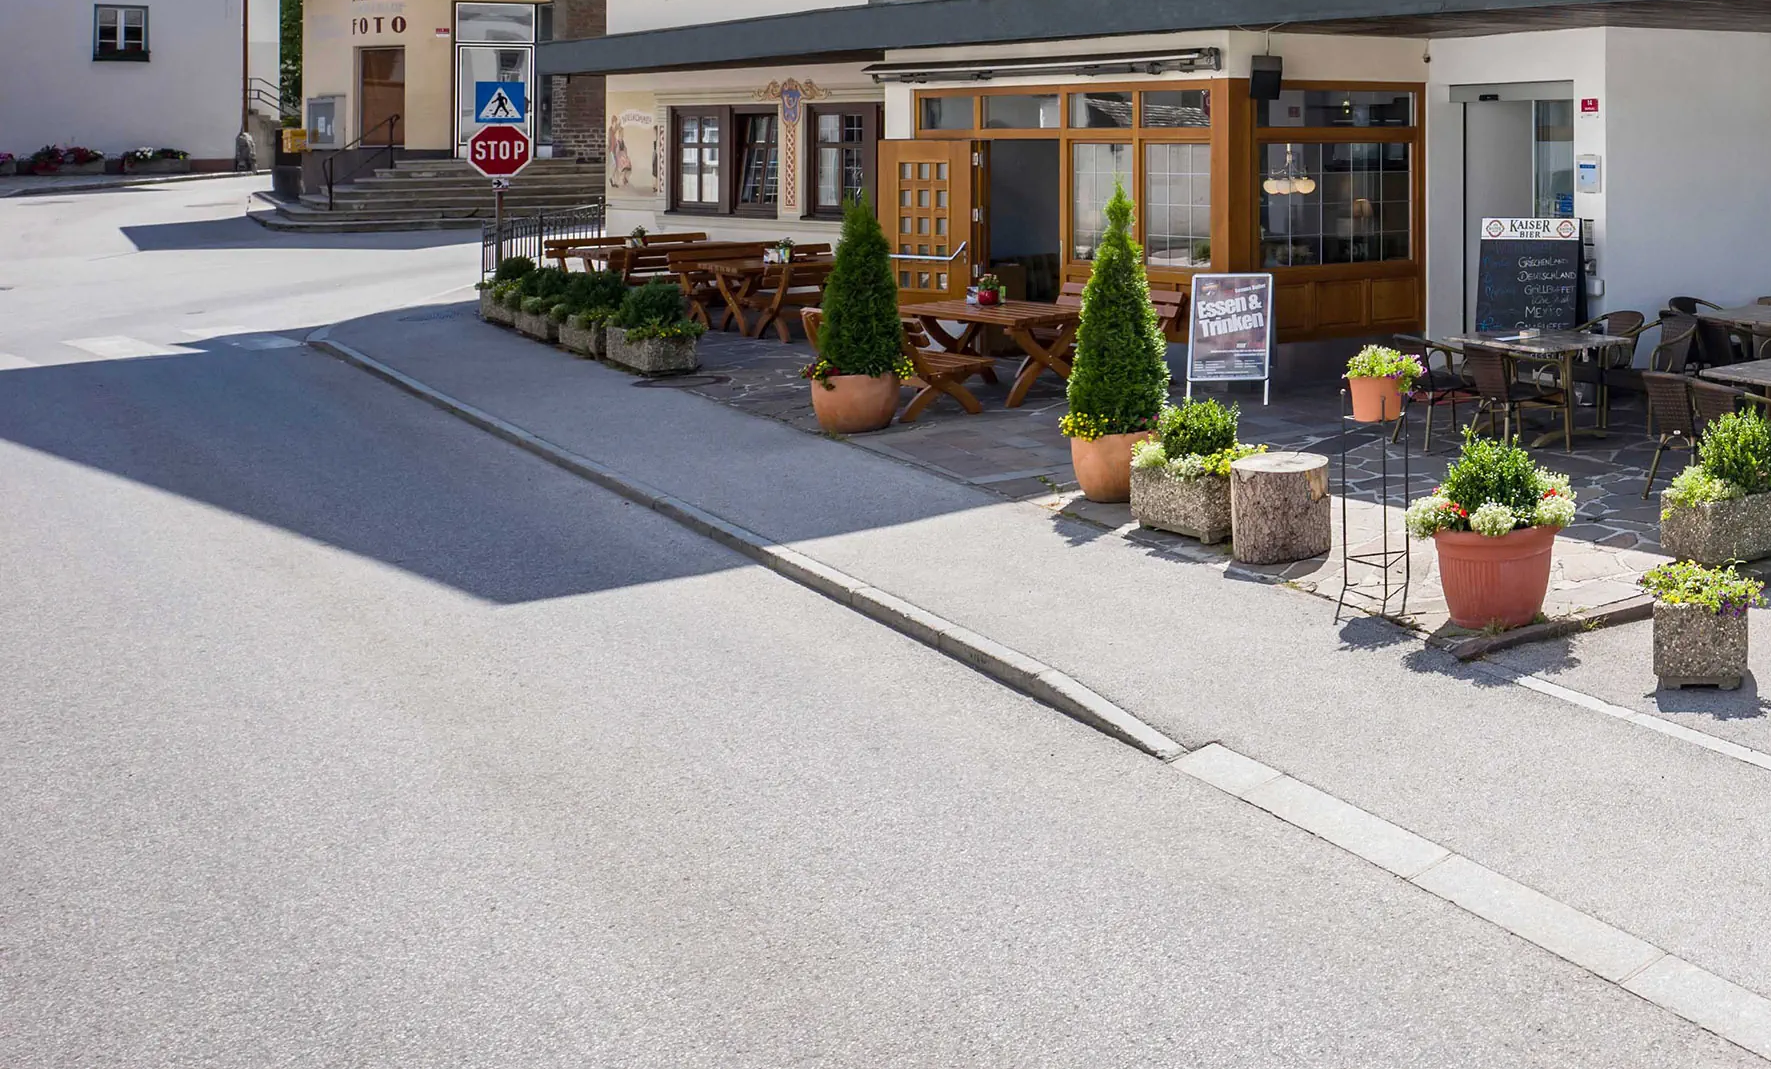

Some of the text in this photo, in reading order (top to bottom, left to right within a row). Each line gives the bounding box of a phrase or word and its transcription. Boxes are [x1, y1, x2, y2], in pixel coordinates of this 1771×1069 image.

[352, 16, 407, 35] FOTO
[475, 140, 525, 160] STOP
[1510, 219, 1551, 233] KAISER
[1197, 294, 1262, 320] Essen &
[1199, 311, 1265, 338] Trinken
